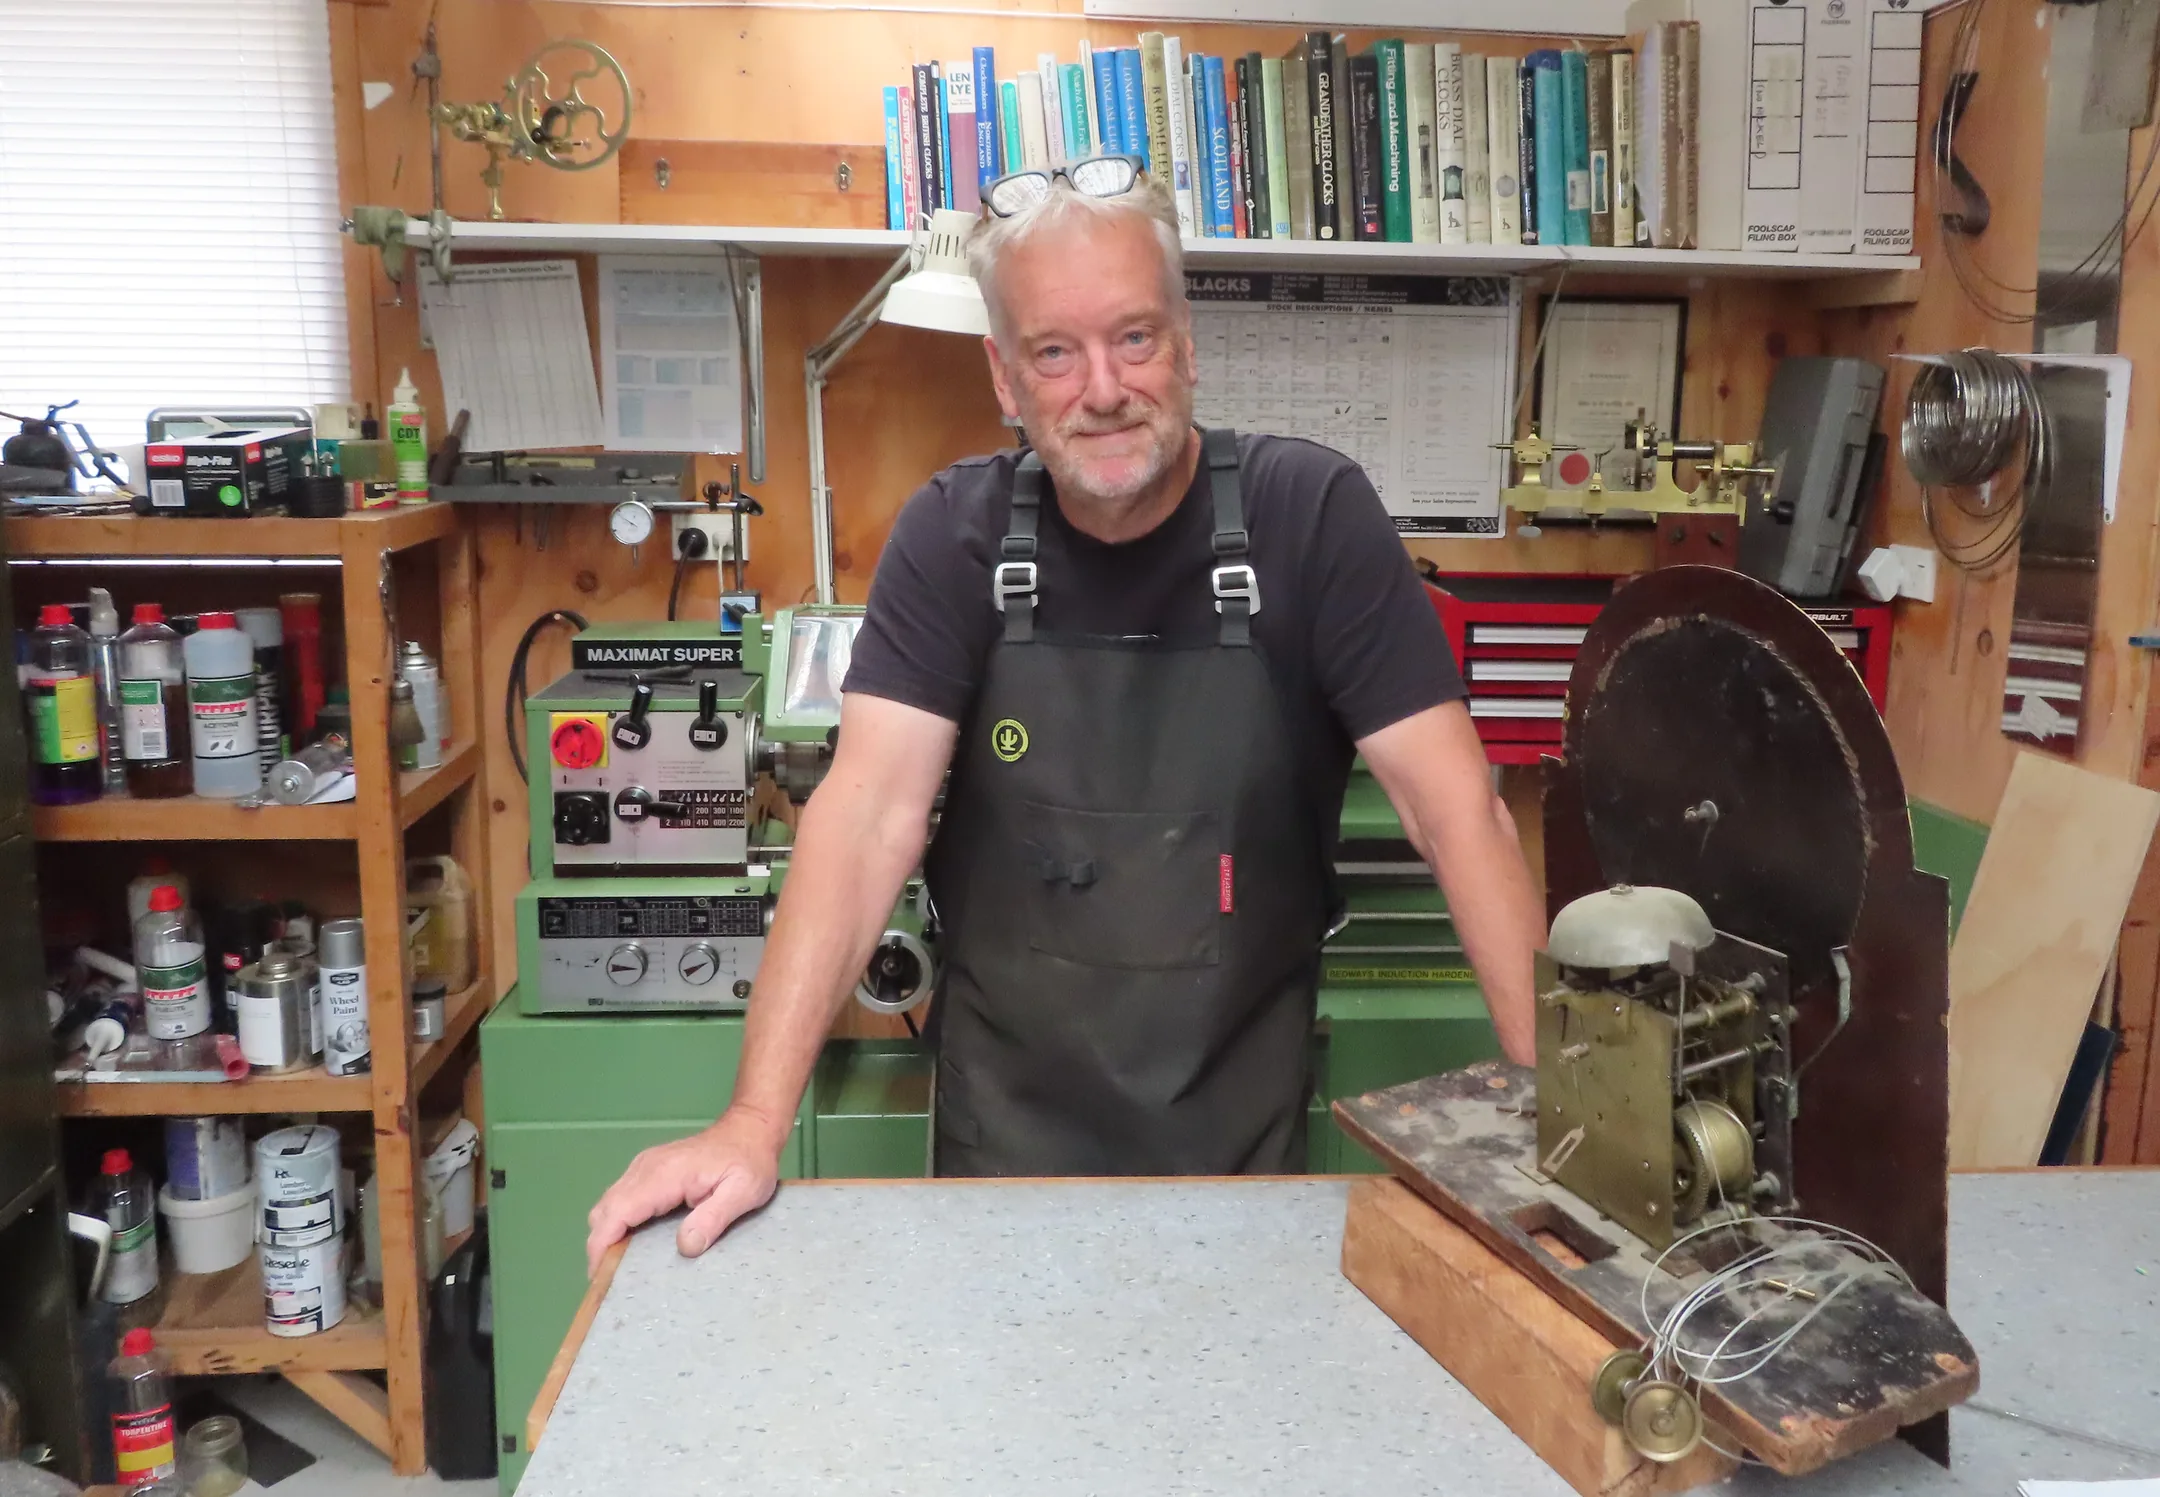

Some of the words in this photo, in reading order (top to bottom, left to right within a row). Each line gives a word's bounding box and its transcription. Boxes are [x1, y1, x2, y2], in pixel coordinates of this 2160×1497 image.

[950, 72, 971, 84] LEN
[1385, 48, 1397, 90] Fitting
[1450, 53, 1462, 102] BRASS
[918, 71, 928, 112] COMPLETE
[950, 83, 972, 96] LYE
[979, 57, 988, 110] Clockmakers
[1101, 67, 1116, 120] LONGCASE
[1123, 67, 1136, 120] LONGCASE
[1171, 82, 1181, 110] DIAL
[1388, 94, 1398, 118] and
[1438, 68, 1450, 130] CLOCKS
[1076, 104, 1085, 126] Clock
[1318, 72, 1332, 158] GRANDFATHER
[1453, 107, 1463, 144] DIAL
[921, 115, 931, 146] BRITISH
[1173, 112, 1185, 158] CLOCKS
[977, 122, 985, 168] ENGLAND
[1389, 121, 1401, 192] Machining
[923, 148, 933, 180] CLOCKS
[1212, 127, 1230, 210] SCOTLAND
[1323, 160, 1334, 205] CLOCKS
[1748, 224, 1796, 233] FOOLSCAP
[1748, 233, 1777, 242] FILING
[1777, 233, 1797, 242] BOX
[1863, 228, 1910, 236] FOOLSCAP
[1183, 278, 1250, 292] BLACKS
[1296, 304, 1353, 312] DESCRIPTIONS
[397, 427, 420, 439] CDT
[1808, 613, 1848, 621] RBUILT
[588, 648, 670, 662] MAXIMAT
[674, 648, 734, 662] SUPER
[736, 648, 742, 661] 1
[1223, 869, 1232, 911] Industrial
[1378, 970, 1429, 978] INDUCTION
[329, 995, 359, 1005] Wheel
[333, 1006, 358, 1015] Paint
[264, 1255, 310, 1269] Resee
[121, 1420, 167, 1437] TURPENTINE
